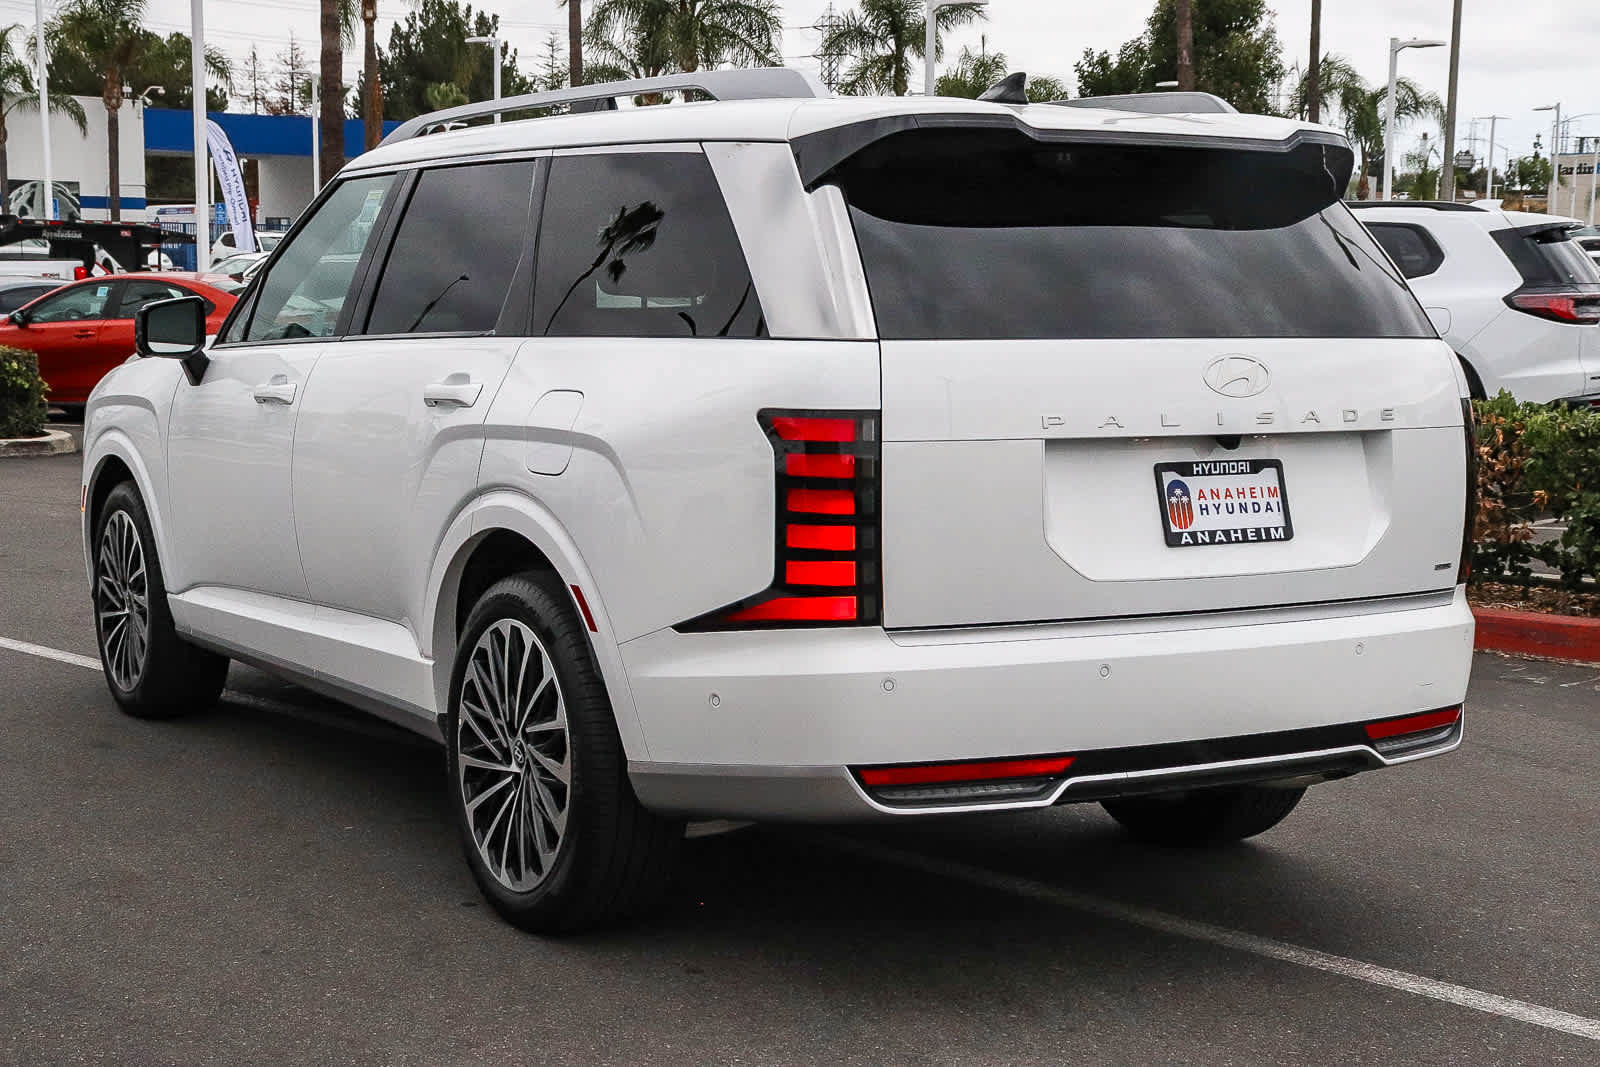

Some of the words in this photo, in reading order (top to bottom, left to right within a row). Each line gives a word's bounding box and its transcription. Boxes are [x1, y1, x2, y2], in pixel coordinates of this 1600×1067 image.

[1041, 407, 1395, 429] PALISADE
[1193, 461, 1250, 475] HYUNDAI
[1198, 487, 1279, 501] ANAHEIM
[1200, 501, 1281, 516] HYUNDAI
[1181, 527, 1285, 545] ANAHEIM
